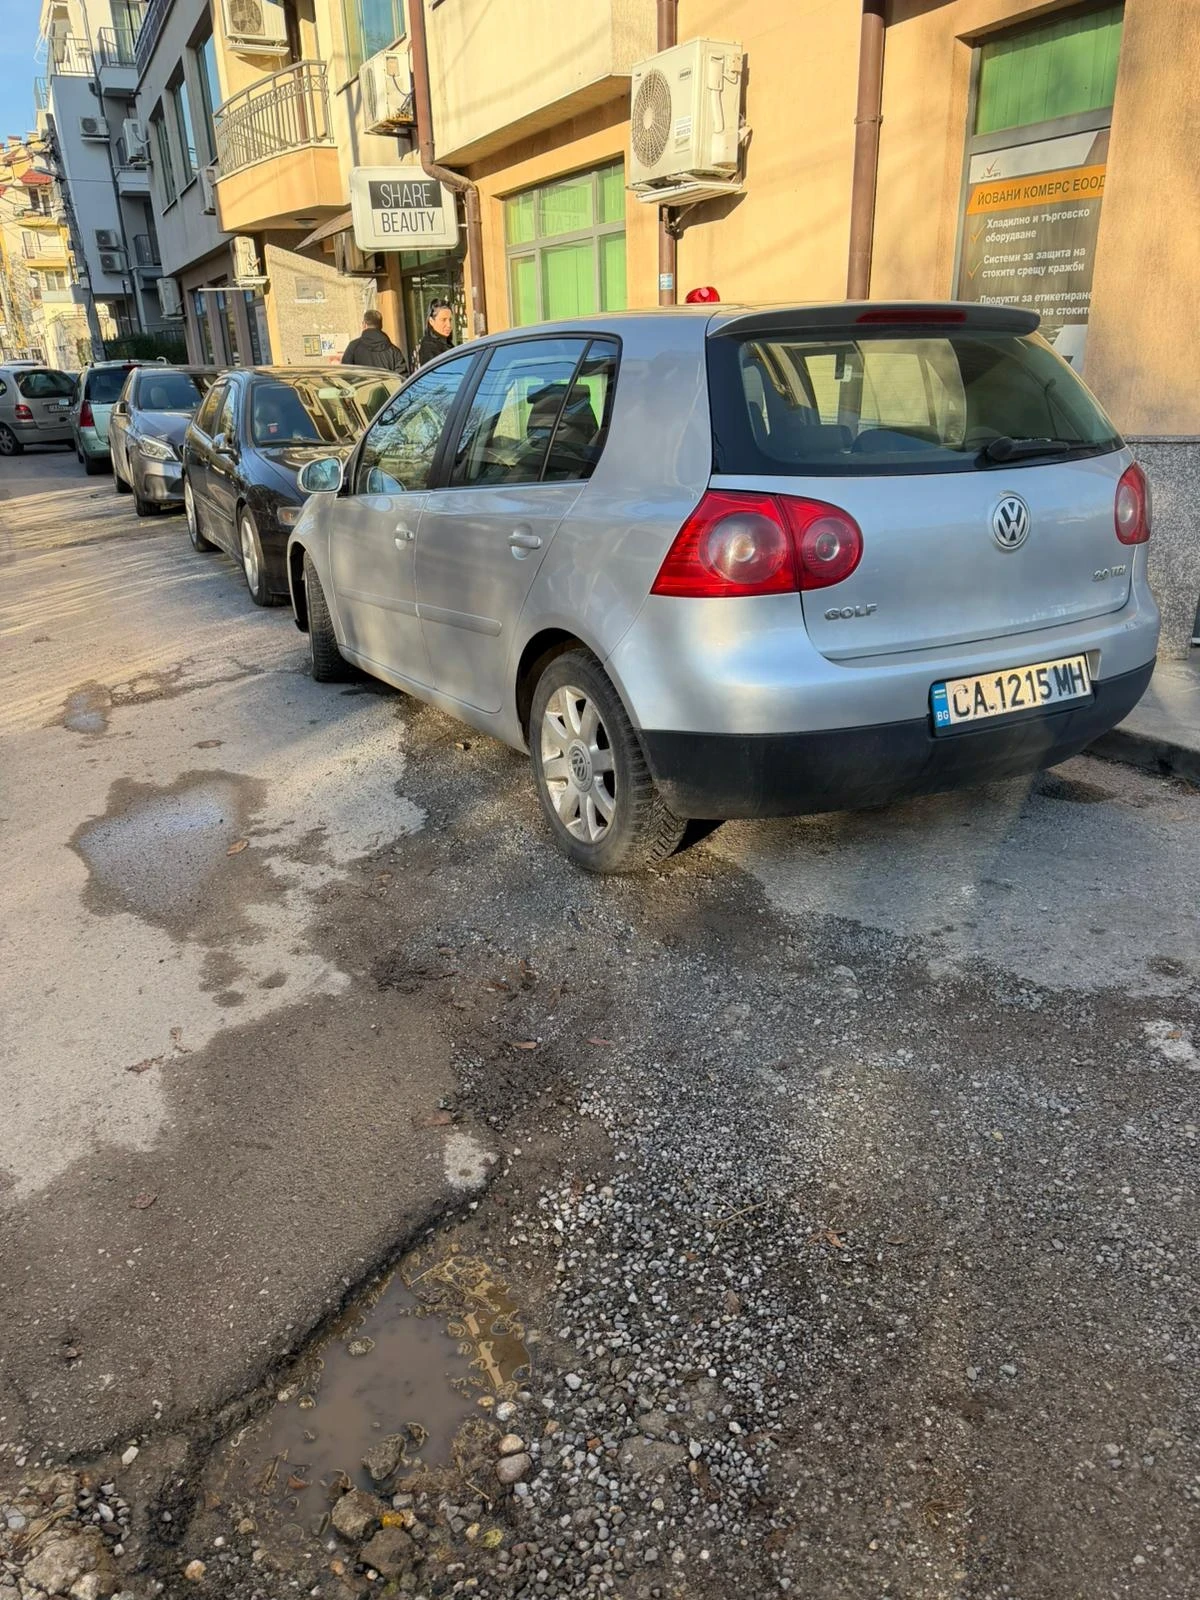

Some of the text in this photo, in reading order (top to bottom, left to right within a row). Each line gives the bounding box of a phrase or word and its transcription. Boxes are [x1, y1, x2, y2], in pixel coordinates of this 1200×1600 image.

[380, 183, 432, 208] SHARE
[977, 174, 1106, 206] ЙОВАНИ КОМЕРС ЕООД
[381, 211, 435, 233] BEAUTY
[986, 207, 1090, 229] Хладилно и търговско
[985, 229, 1037, 244] оборудване
[983, 246, 1086, 265] Системи за защита на
[982, 261, 1085, 278] стоките срещу кражби
[979, 293, 1020, 306] Продукти
[1022, 294, 1033, 303] за
[1042, 307, 1054, 317] на
[1056, 305, 1089, 316] стокит
[824, 603, 878, 620] GOLF
[936, 711, 949, 721] BG
